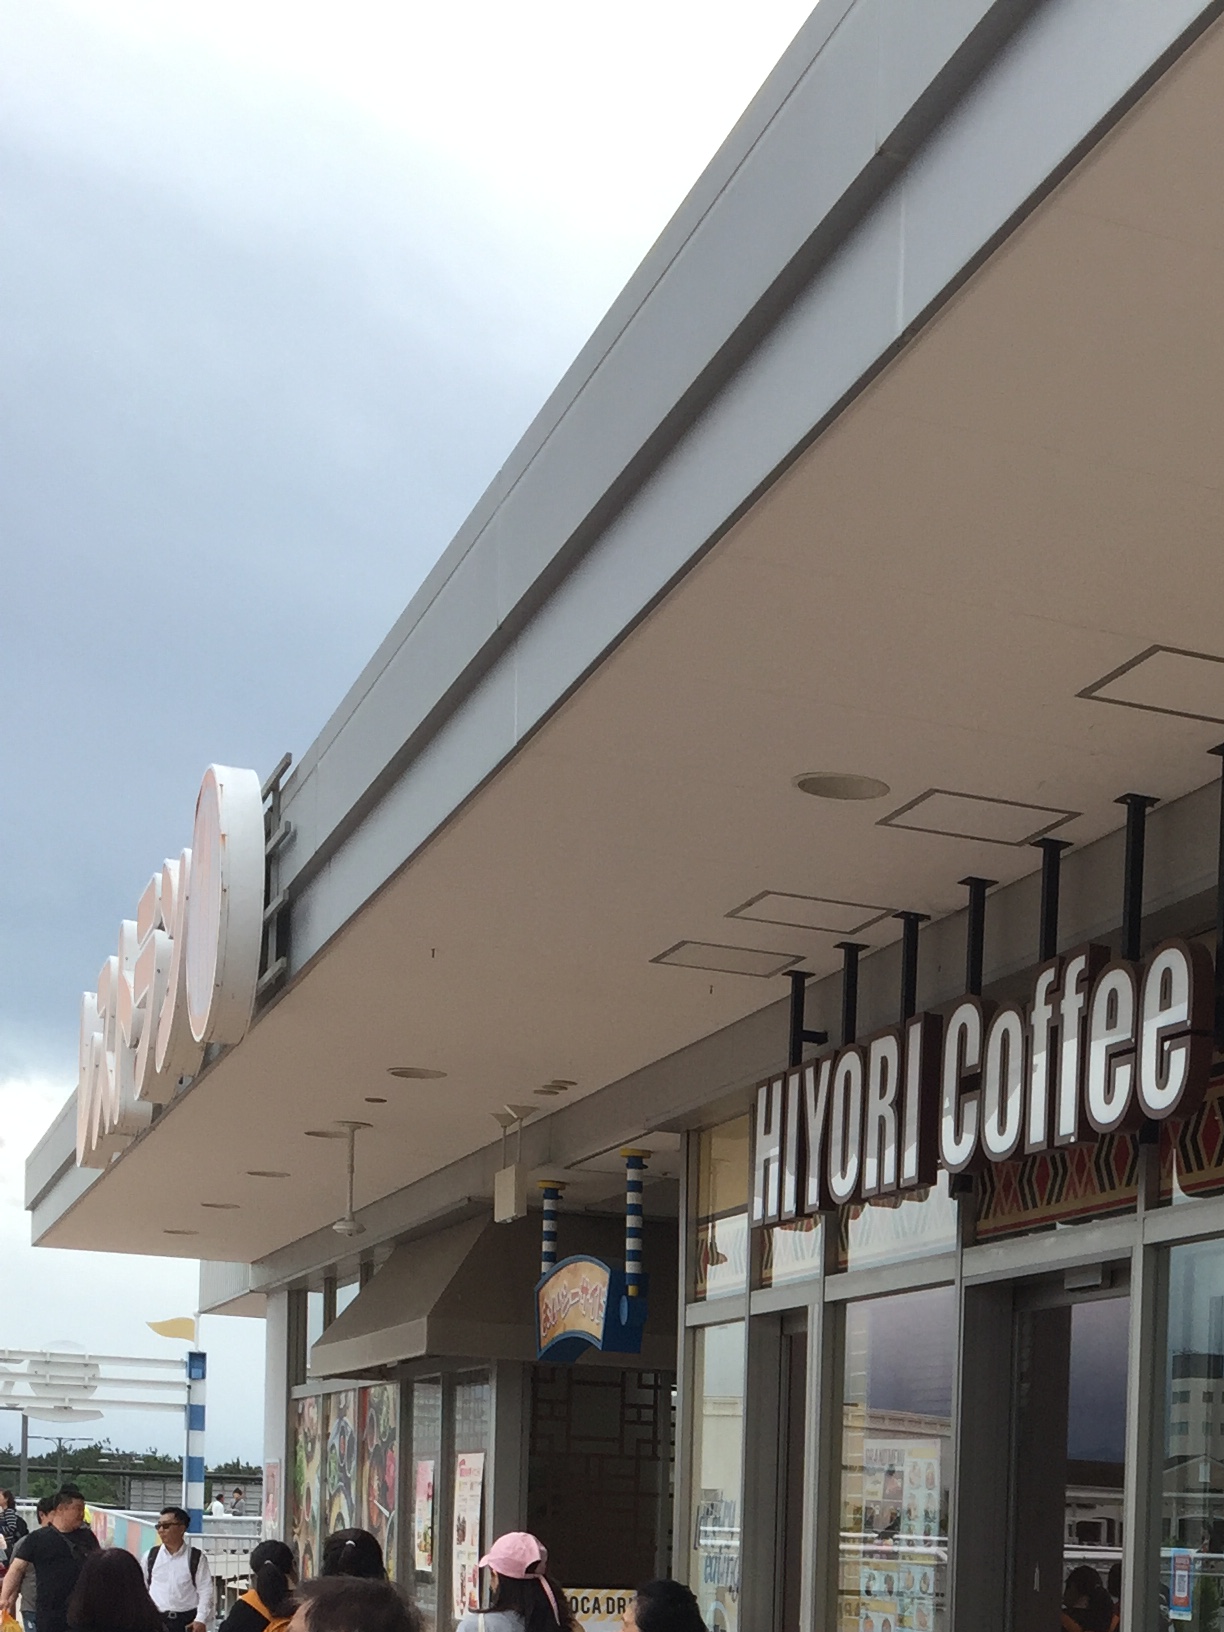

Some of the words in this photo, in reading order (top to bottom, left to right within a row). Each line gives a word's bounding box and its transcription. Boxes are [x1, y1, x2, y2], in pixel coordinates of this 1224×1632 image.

[752, 1020, 923, 1226] HIYORI
[940, 946, 1192, 1167] Coffee
[570, 1596, 601, 1615] OCA
[606, 1597, 628, 1615] DR
